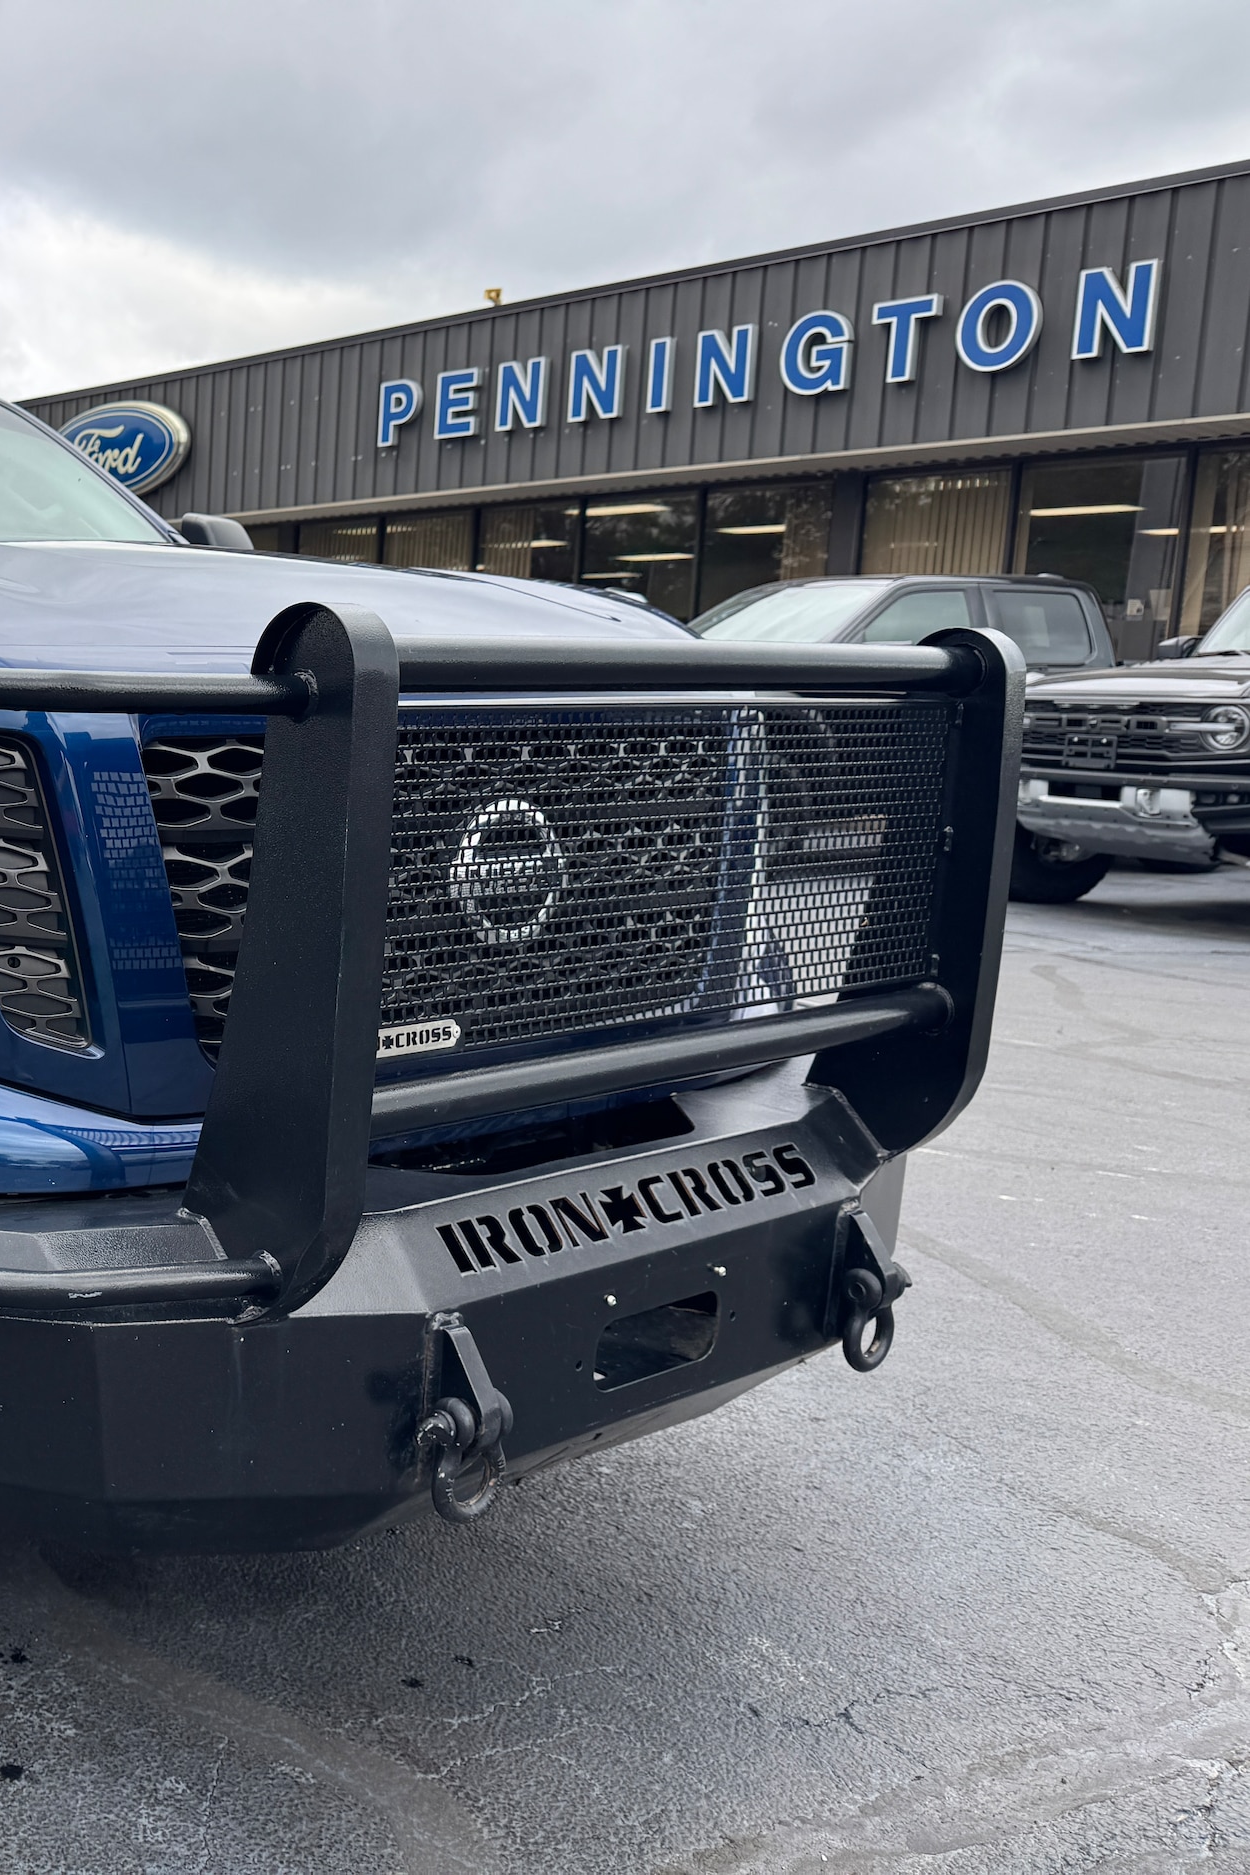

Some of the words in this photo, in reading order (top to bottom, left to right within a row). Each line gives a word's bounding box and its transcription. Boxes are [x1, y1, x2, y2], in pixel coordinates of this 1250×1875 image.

[378, 258, 1159, 447] PENNINGTON
[396, 1025, 452, 1049] CROSS
[436, 1192, 607, 1274] IRON
[637, 1144, 816, 1224] CROSS
